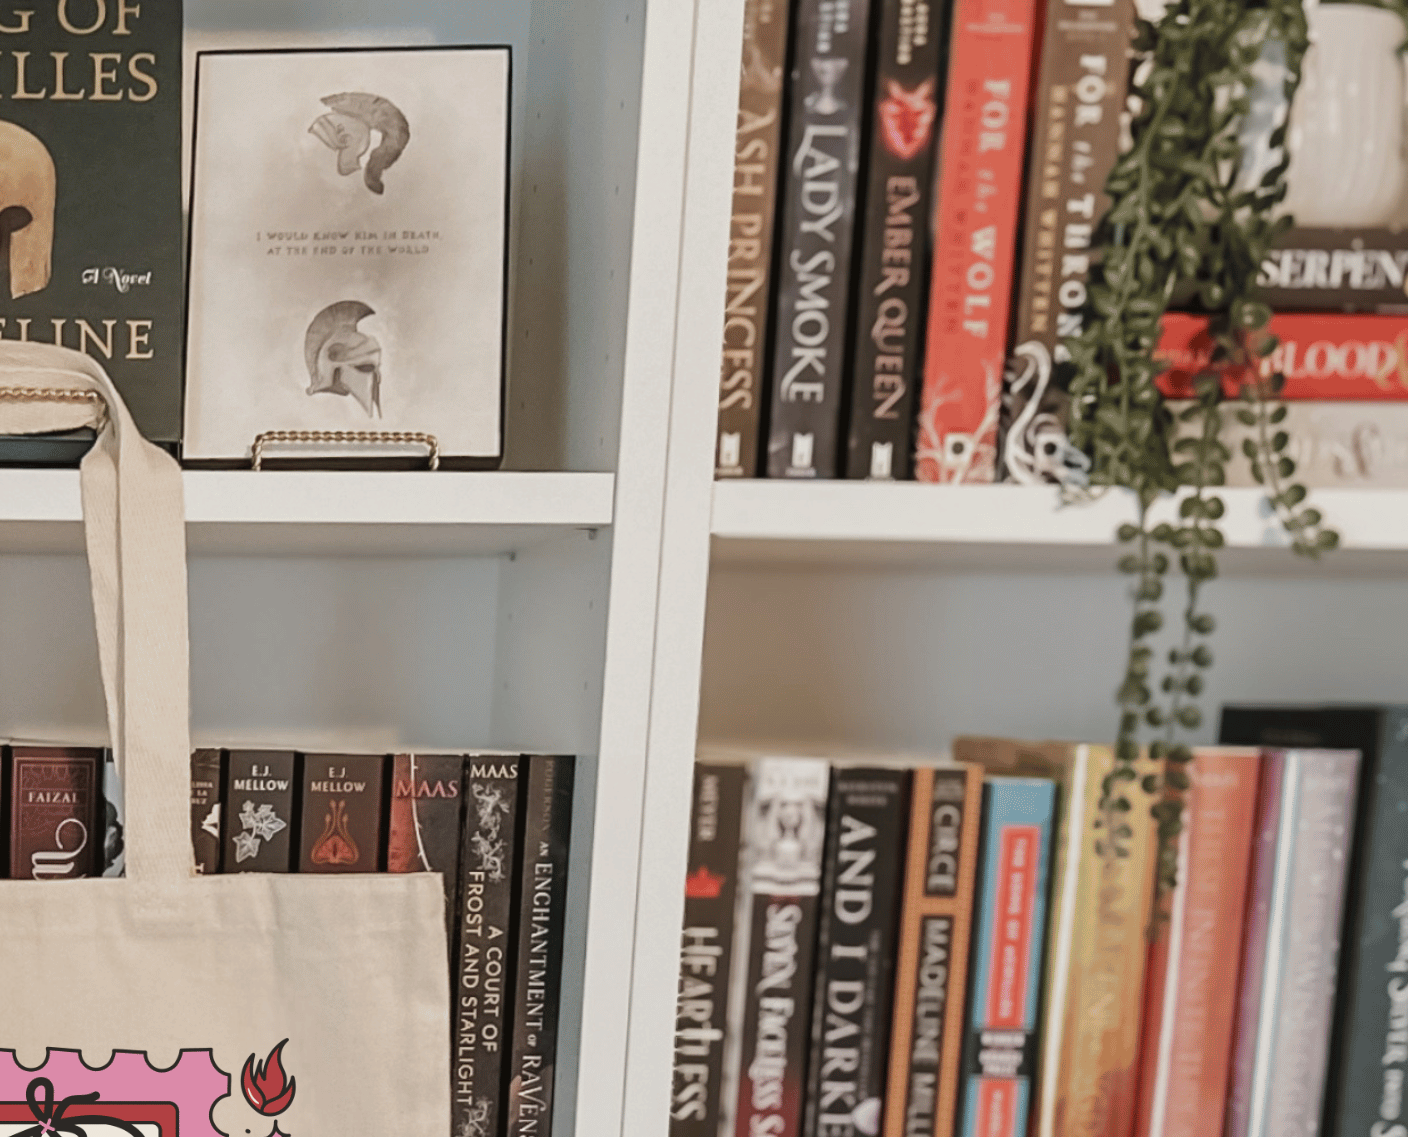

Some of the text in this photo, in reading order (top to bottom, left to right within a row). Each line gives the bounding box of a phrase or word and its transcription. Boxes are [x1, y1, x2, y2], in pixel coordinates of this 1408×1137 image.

[58, 0, 140, 36] OF
[976, 78, 1012, 153] FOR
[1074, 53, 1108, 127] FOR
[266, 230, 309, 242] WOULD
[312, 230, 350, 242] KNOW
[354, 230, 379, 242] HIM
[382, 230, 398, 242] IN
[266, 245, 285, 257] AT
[286, 245, 309, 257] THE
[312, 244, 338, 257] END
[359, 244, 384, 257] THE
[386, 244, 431, 257] WORLD
[719, 108, 777, 411] ASH PRINCESS
[780, 123, 850, 404] LADY SMOKE
[81, 266, 153, 293] A Novel
[869, 175, 921, 421] EMBER QUEEN
[962, 223, 998, 338] WOLF
[233, 778, 289, 793] MELLOW
[250, 764, 273, 778] E.J.
[310, 779, 366, 794] MELLOW
[328, 766, 348, 780] E.J.
[395, 778, 459, 800] MAAS
[468, 761, 519, 780] MAAS
[537, 840, 550, 859] AN
[834, 813, 879, 925] AND
[925, 802, 963, 894] CIRCE
[525, 860, 554, 1033] ENCHANTMENT
[830, 943, 869, 962] I
[457, 870, 486, 1106] FROST AND STARLIGHT
[480, 925, 503, 1055] A COURT OF
[670, 924, 724, 1123] HEARTLESS
[915, 918, 952, 1065] MADELINE
